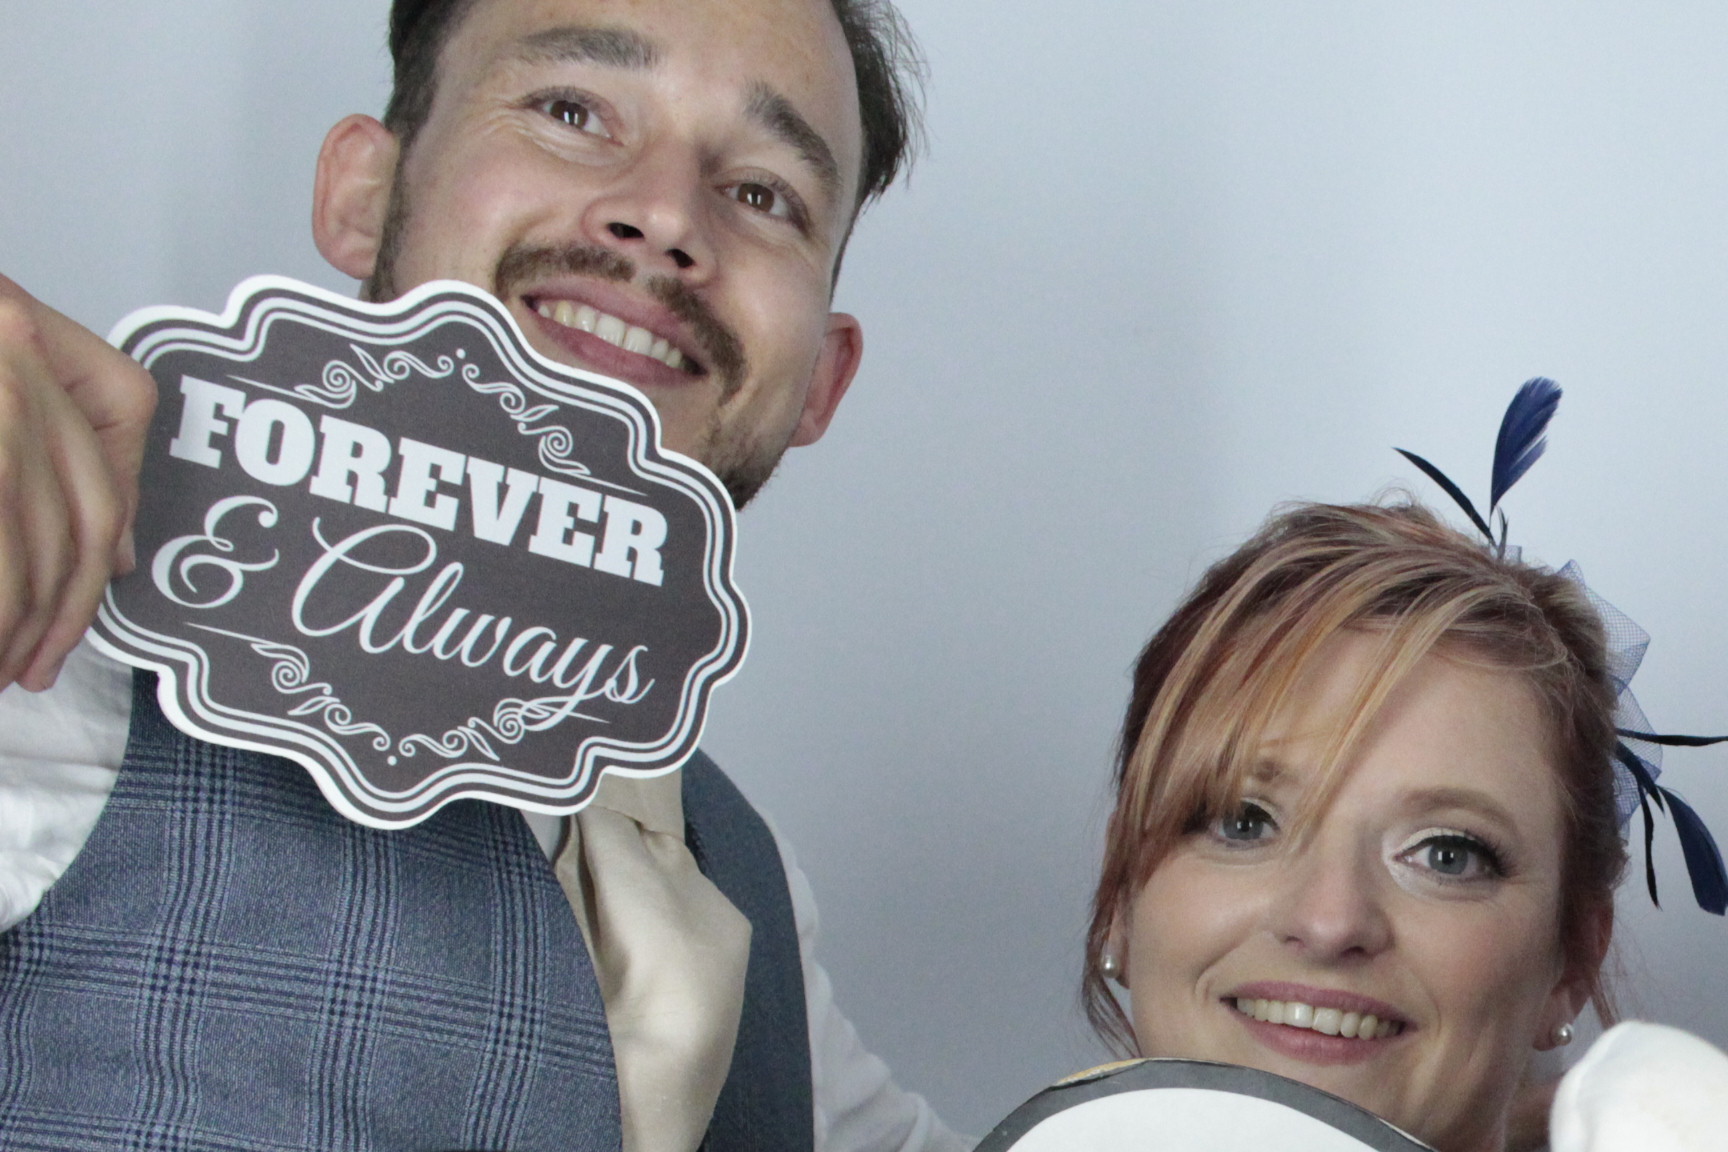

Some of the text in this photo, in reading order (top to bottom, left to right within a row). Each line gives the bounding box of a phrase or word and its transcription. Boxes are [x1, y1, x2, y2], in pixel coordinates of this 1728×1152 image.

[169, 374, 669, 587] FOREVER
[151, 495, 656, 731] & Always
